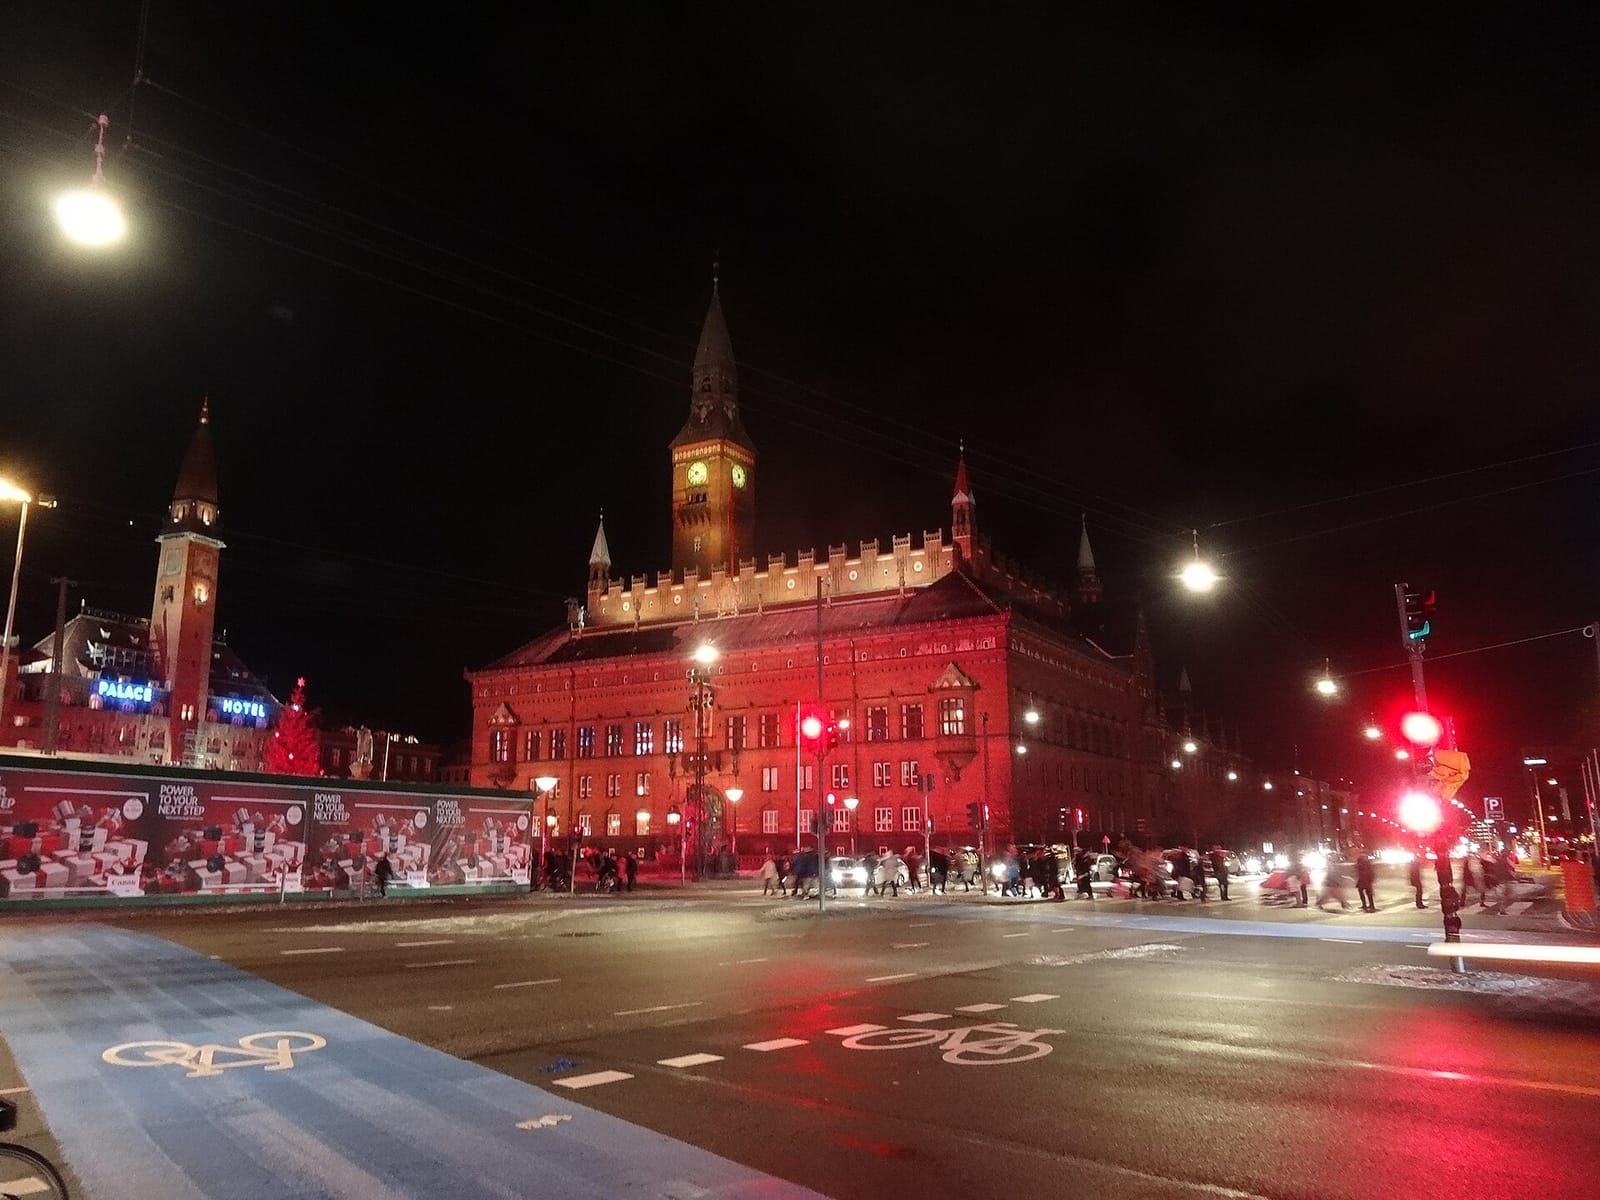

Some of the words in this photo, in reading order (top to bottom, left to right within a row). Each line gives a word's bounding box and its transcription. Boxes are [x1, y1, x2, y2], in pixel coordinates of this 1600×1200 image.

[98, 680, 153, 703] PALACE
[222, 698, 266, 718] HOTEL
[160, 784, 194, 796] POWER
[159, 794, 172, 805] TO
[173, 795, 199, 806] YOUR
[314, 793, 341, 803] POWER
[158, 804, 182, 815] NEXT
[183, 805, 205, 816] STEP
[314, 802, 324, 811] TO
[325, 802, 345, 813] YOUR
[1489, 799, 1499, 810] P
[313, 811, 333, 821] NEXT
[333, 811, 351, 822] STEP
